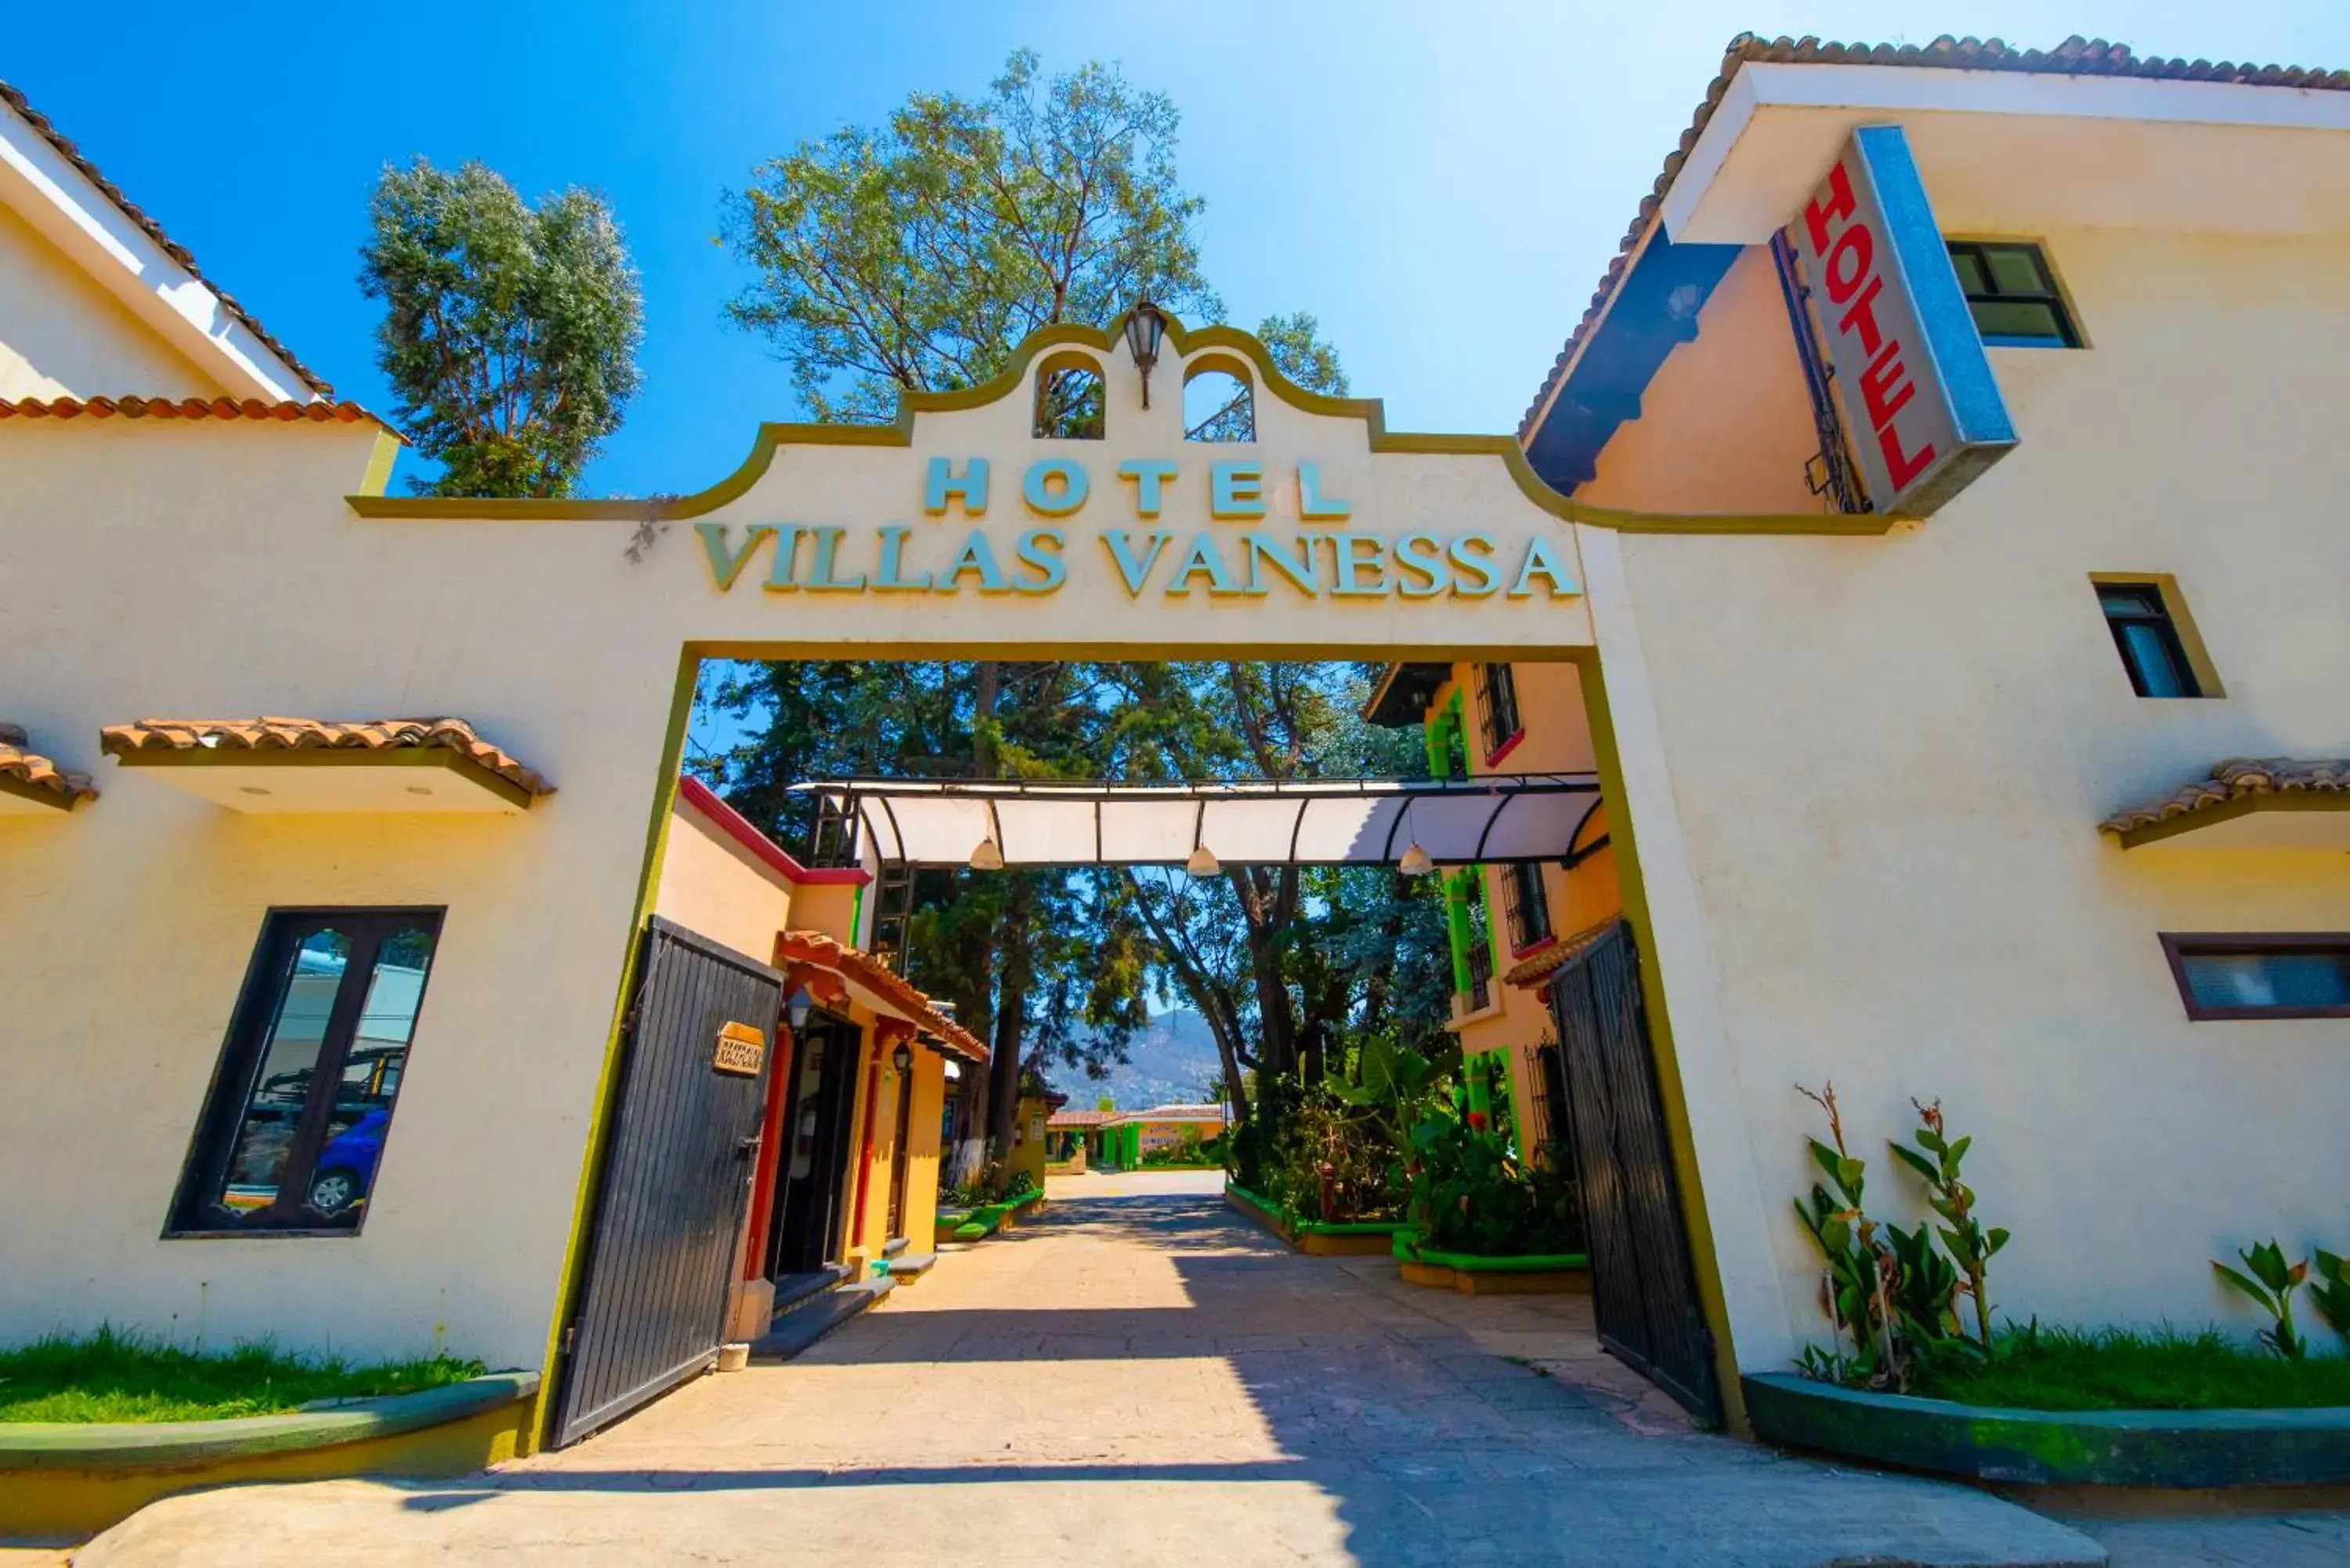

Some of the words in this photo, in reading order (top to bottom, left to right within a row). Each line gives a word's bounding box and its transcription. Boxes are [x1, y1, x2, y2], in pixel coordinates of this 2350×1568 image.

[1805, 161, 1936, 493] HOTEL
[924, 457, 1351, 520] HOTEL
[694, 522, 1067, 596] VILLAS
[1100, 529, 1582, 600] VANESSA
